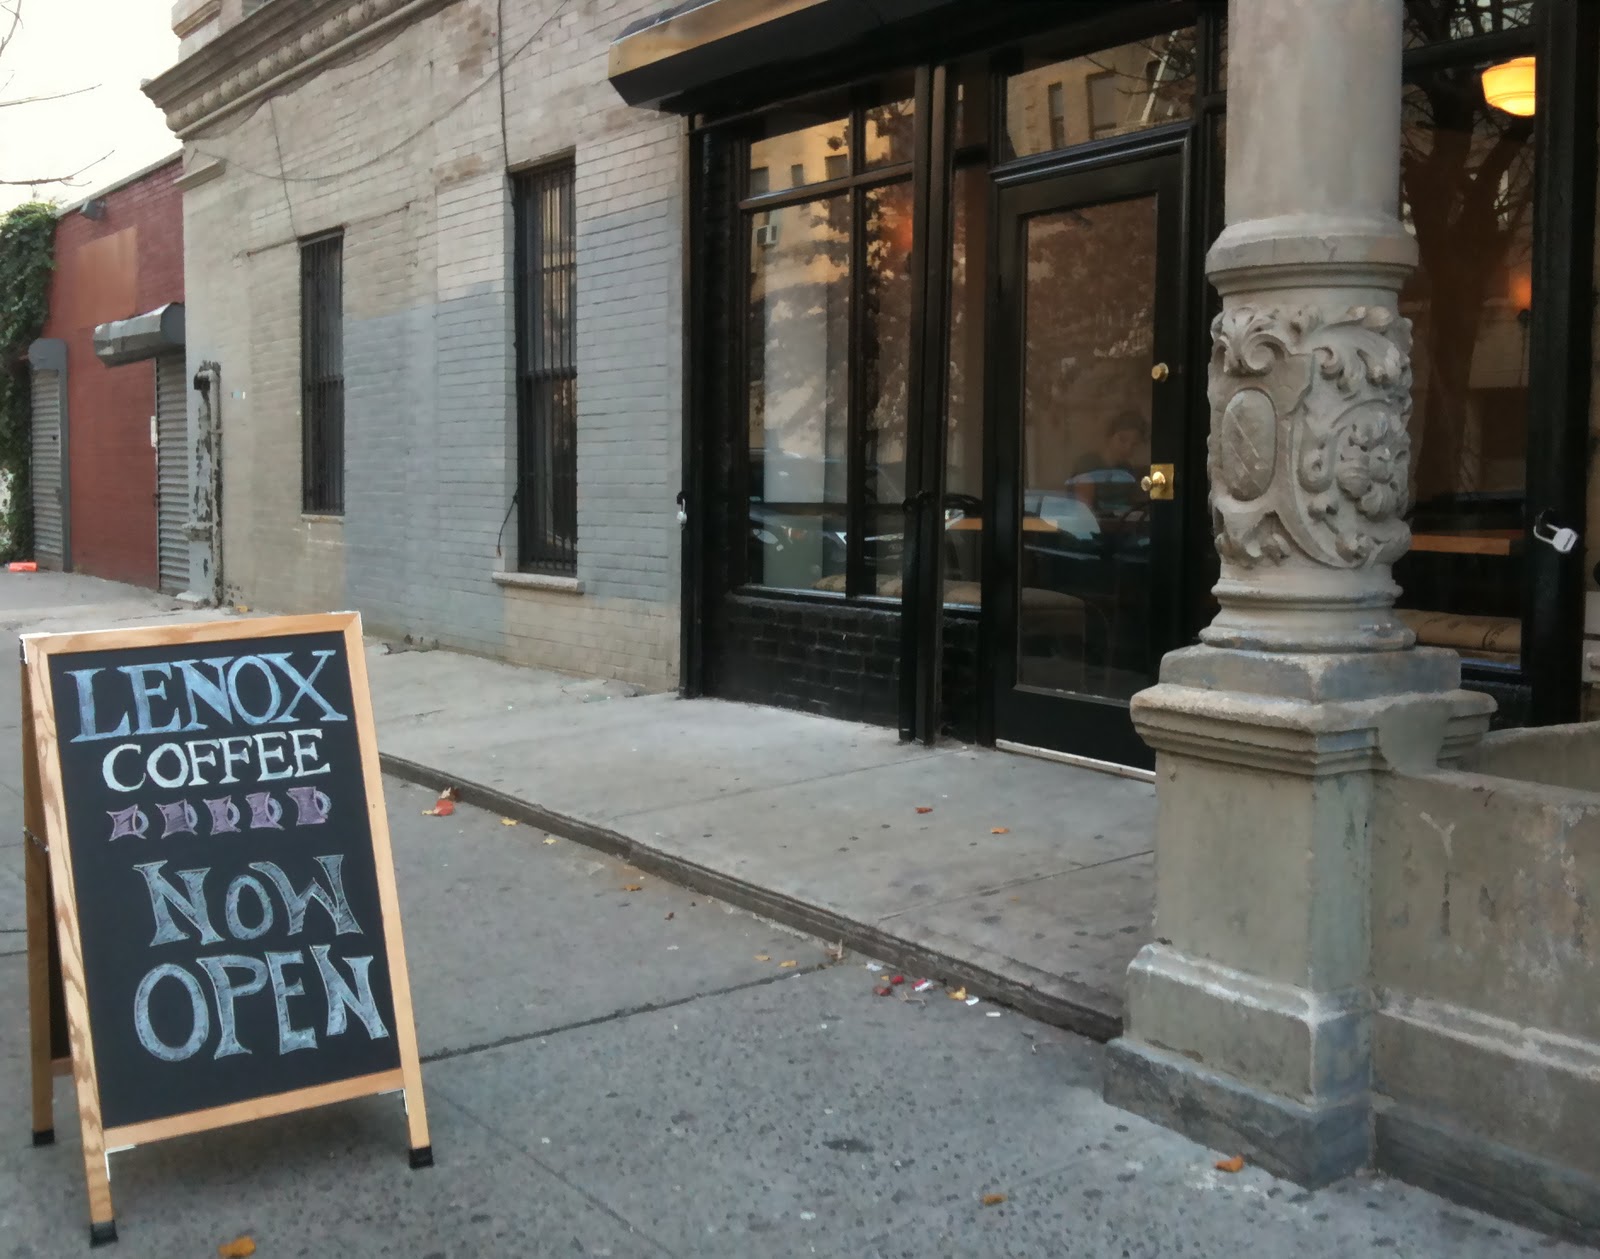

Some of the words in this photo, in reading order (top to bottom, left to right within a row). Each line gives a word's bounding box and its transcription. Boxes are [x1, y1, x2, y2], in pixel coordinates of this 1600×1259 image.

[64, 650, 348, 743] LENOX
[102, 729, 331, 792] COFFEE
[132, 854, 364, 947] NOW
[134, 944, 390, 1061] OPEN
